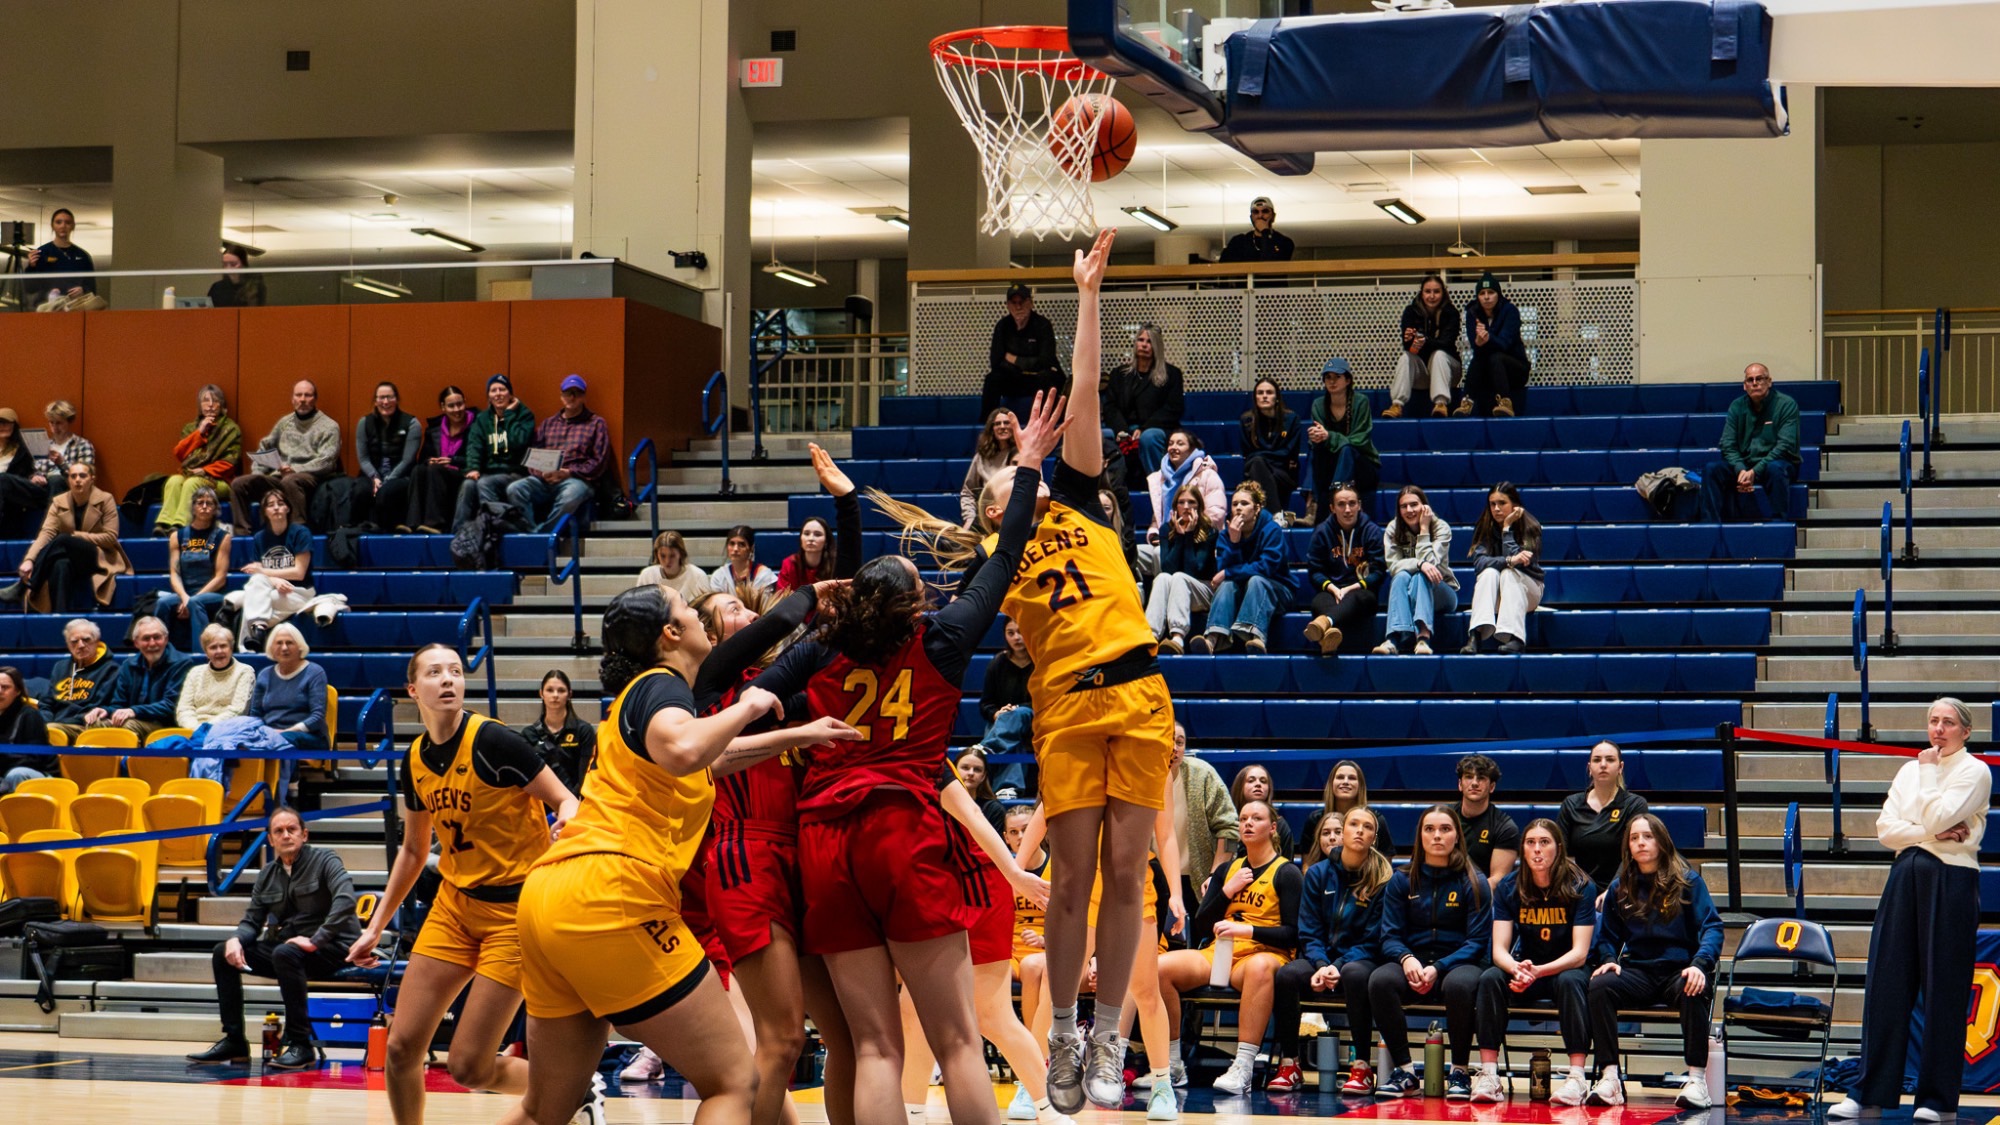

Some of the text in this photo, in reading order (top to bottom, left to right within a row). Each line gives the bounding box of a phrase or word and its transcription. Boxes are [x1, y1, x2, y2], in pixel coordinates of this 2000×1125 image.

[748, 60, 777, 82] EXIT
[1036, 558, 1094, 614] 21
[843, 668, 914, 741] 24
[356, 893, 377, 922] Q
[1540, 927, 1551, 942] Q
[1775, 920, 1804, 953] Q
